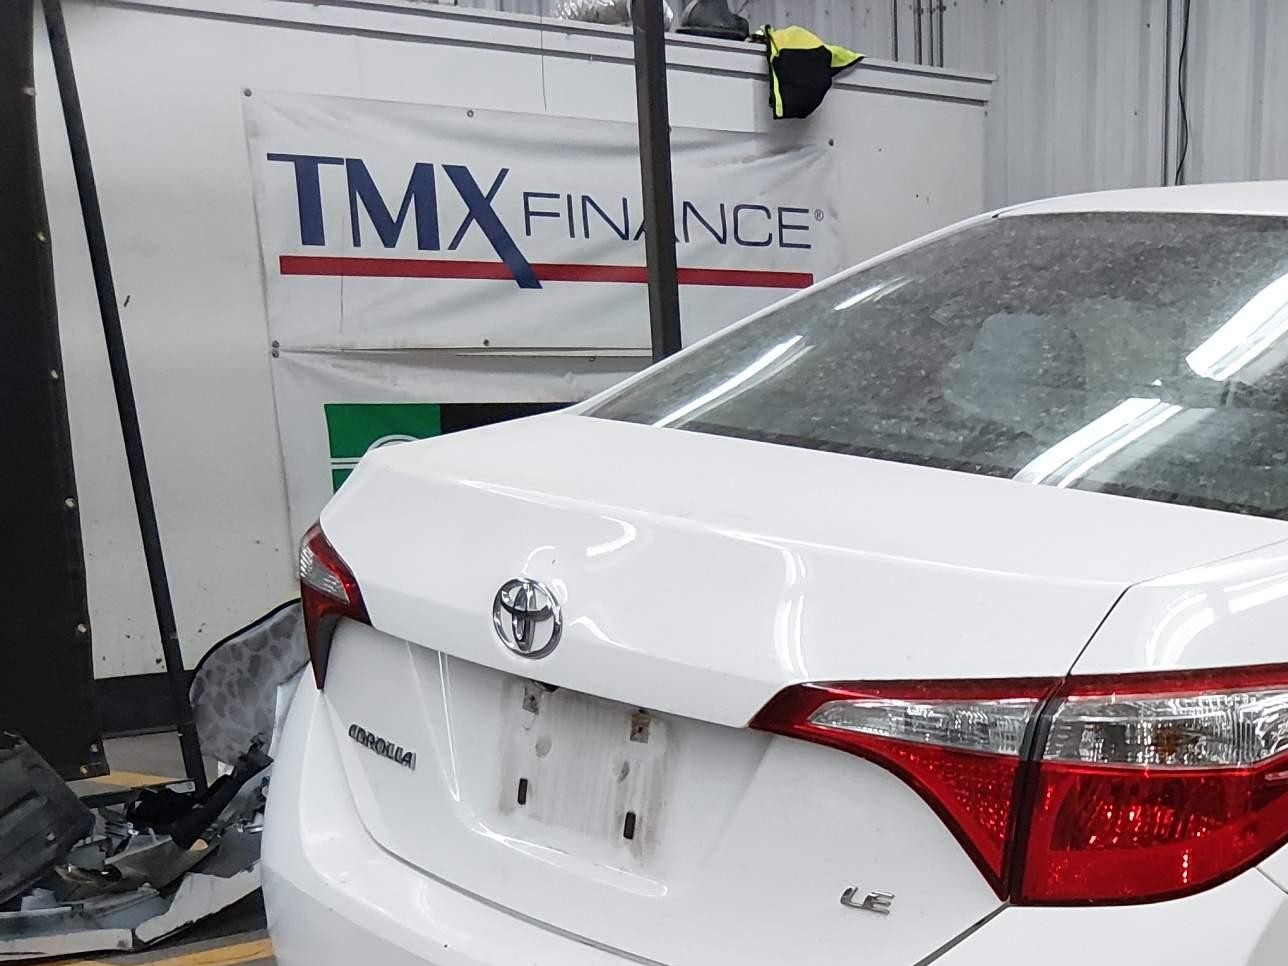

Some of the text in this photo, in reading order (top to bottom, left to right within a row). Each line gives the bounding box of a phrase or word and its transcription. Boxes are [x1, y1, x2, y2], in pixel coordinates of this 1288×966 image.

[266, 152, 543, 289] TMX
[348, 723, 417, 771] COROLLA
[840, 886, 895, 915] LE
